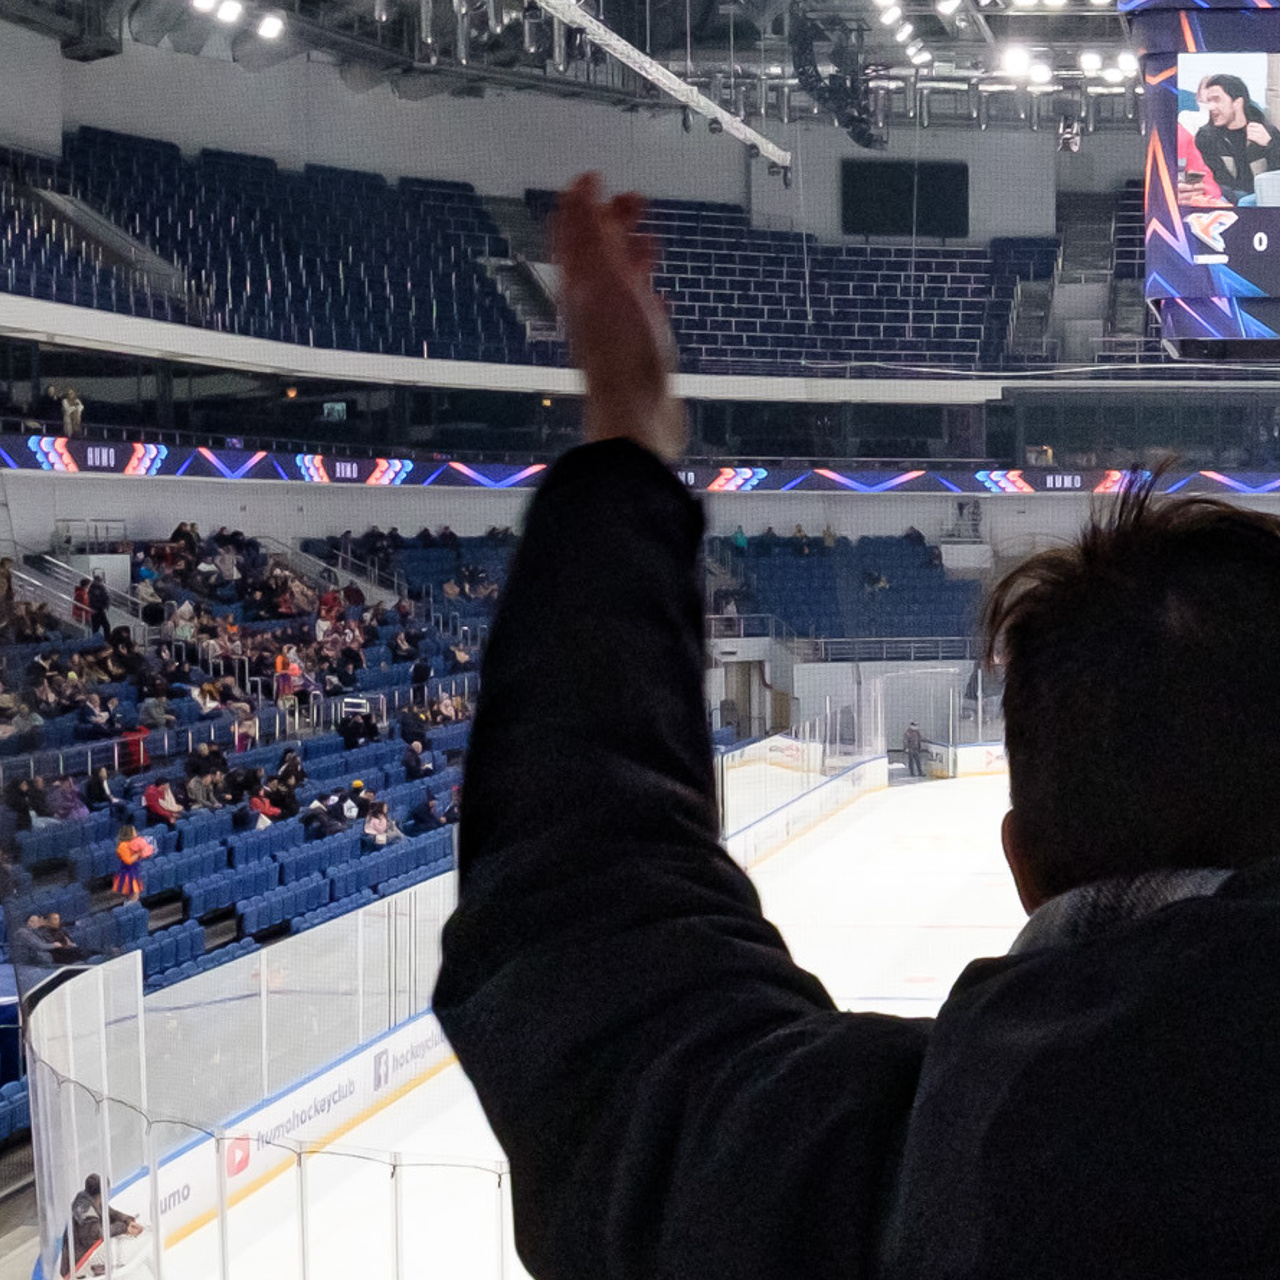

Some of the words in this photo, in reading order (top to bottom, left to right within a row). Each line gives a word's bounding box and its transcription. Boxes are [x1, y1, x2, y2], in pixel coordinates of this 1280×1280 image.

[1253, 232, 1269, 251] 0
[1046, 475, 1081, 488] HUMO
[257, 1080, 355, 1151] humohockeyclub
